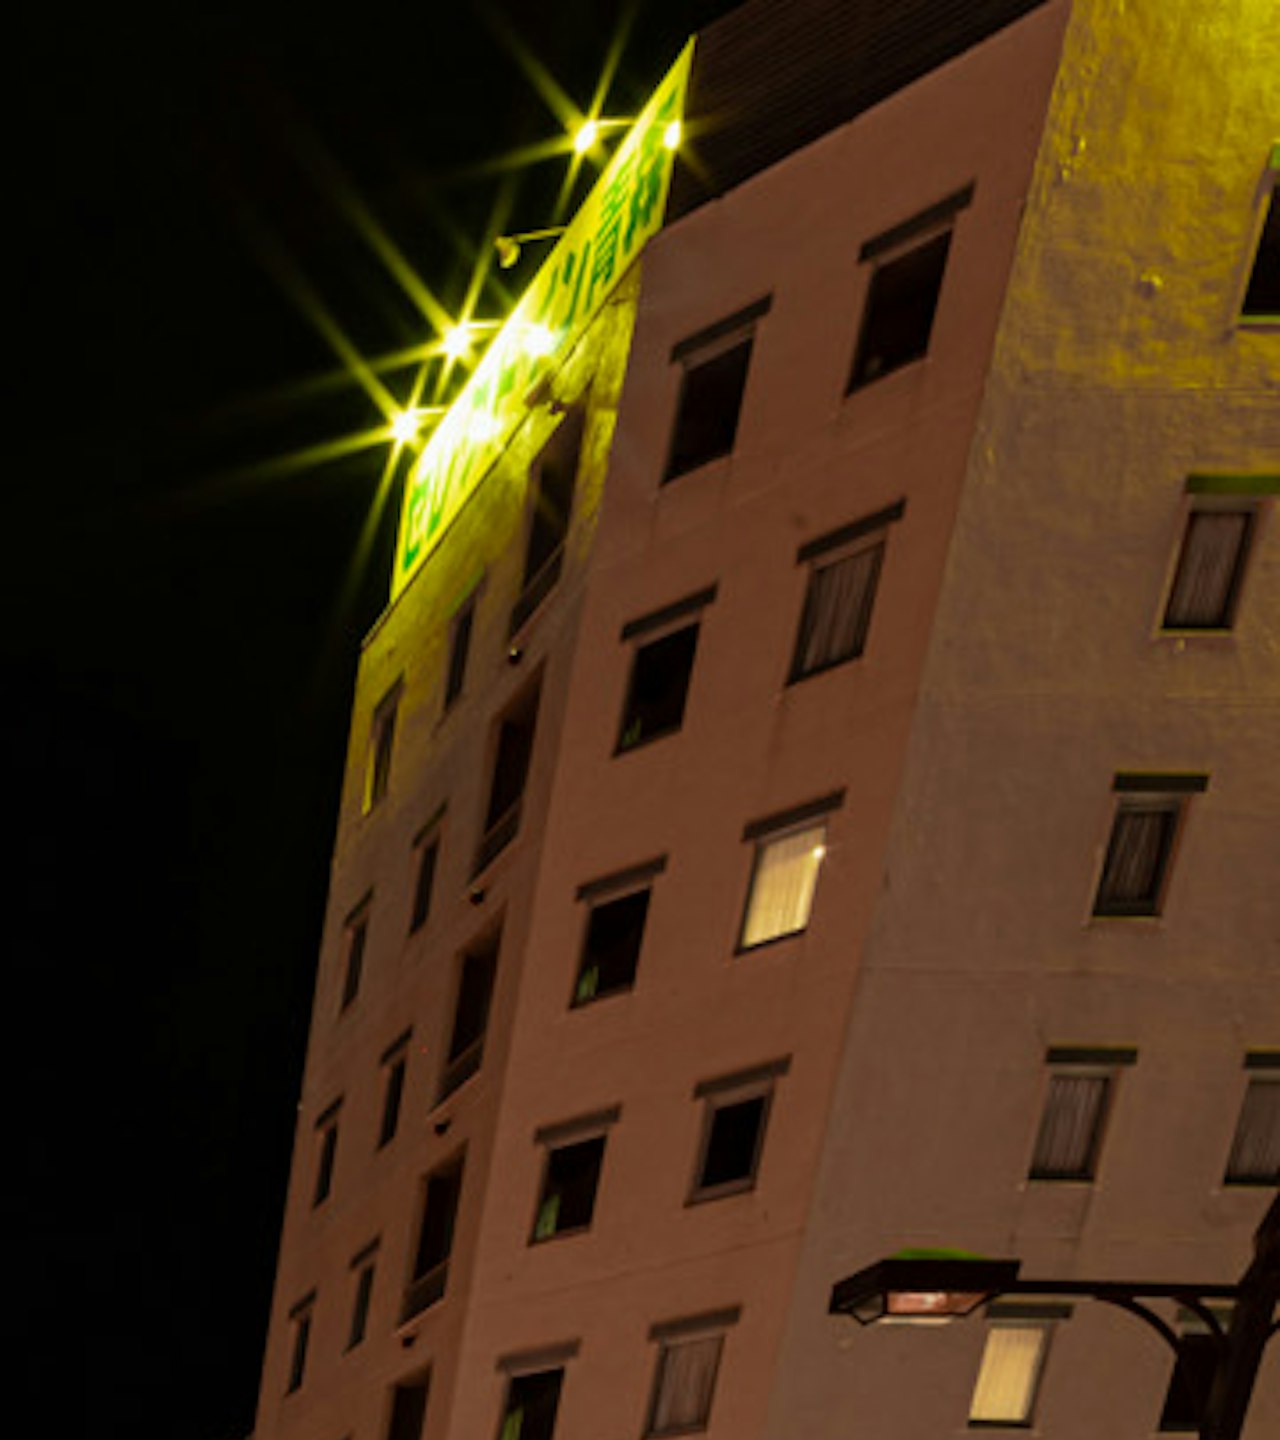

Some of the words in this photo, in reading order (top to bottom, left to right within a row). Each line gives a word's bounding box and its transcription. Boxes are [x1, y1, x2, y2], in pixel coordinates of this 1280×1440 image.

[403, 90, 677, 570] セレン青森
